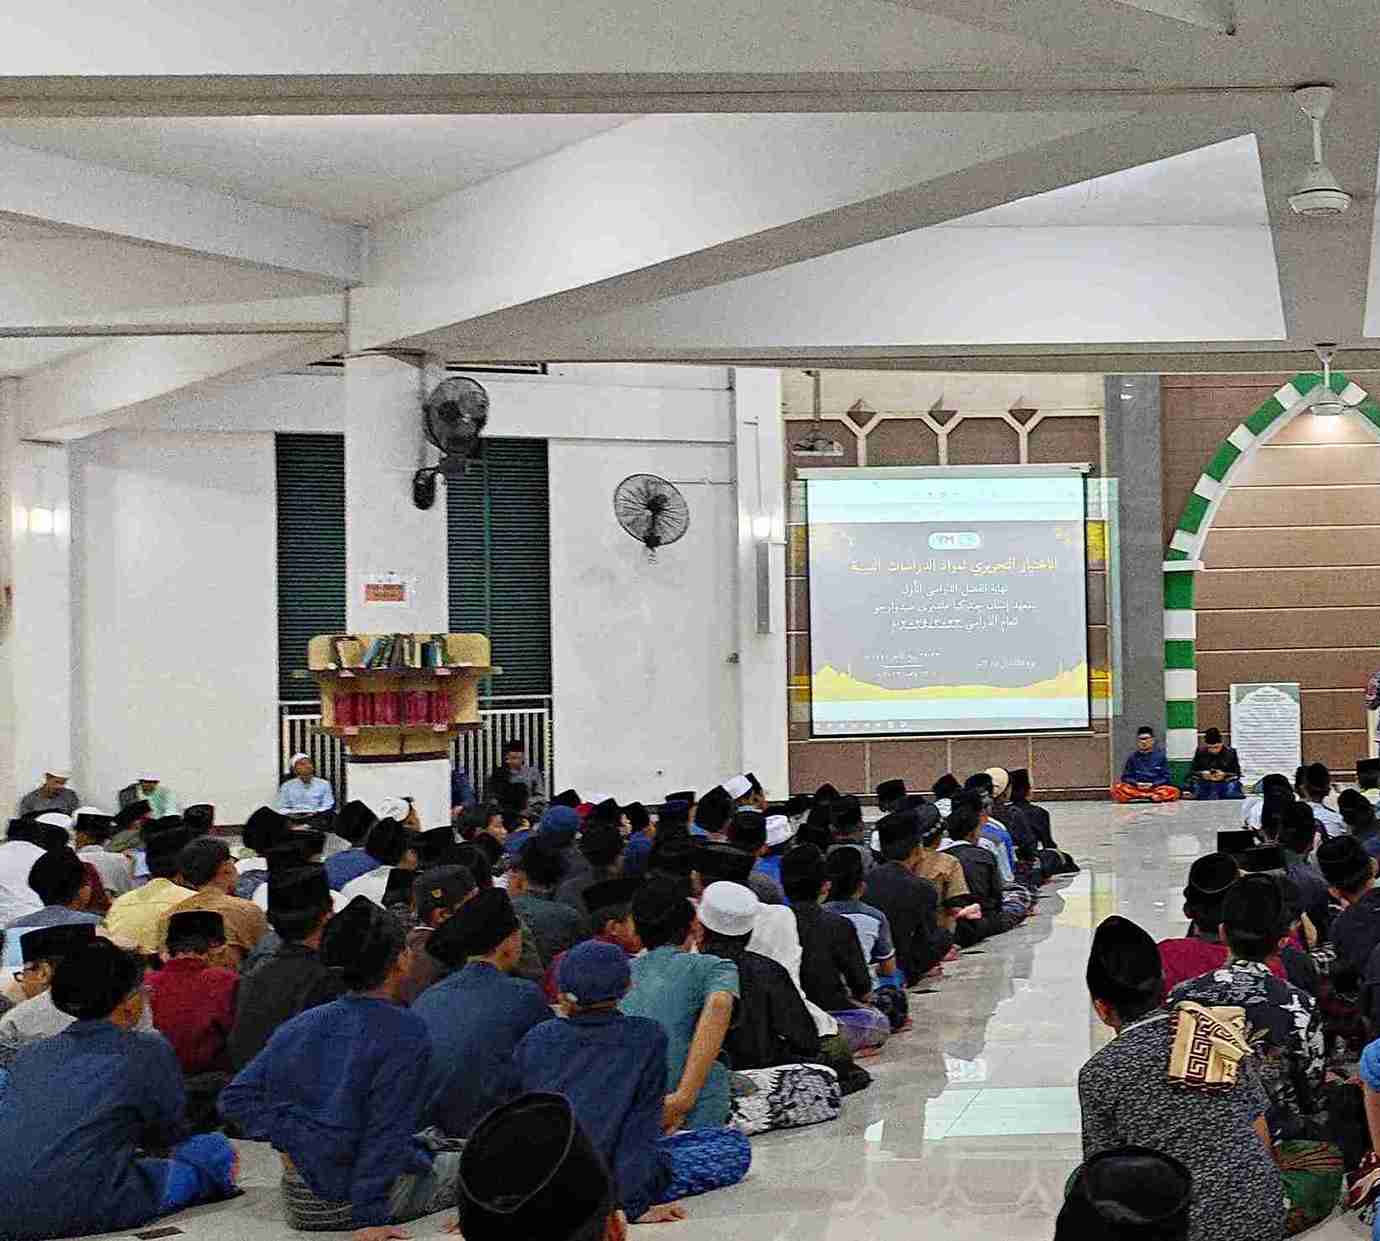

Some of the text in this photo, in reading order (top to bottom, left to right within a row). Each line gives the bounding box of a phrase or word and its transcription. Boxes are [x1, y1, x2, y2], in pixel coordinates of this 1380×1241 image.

[887, 557, 936, 575] الدراسات
[900, 579, 922, 597] الأول
[926, 582, 958, 599] الدراسي
[960, 582, 988, 598] الفصل
